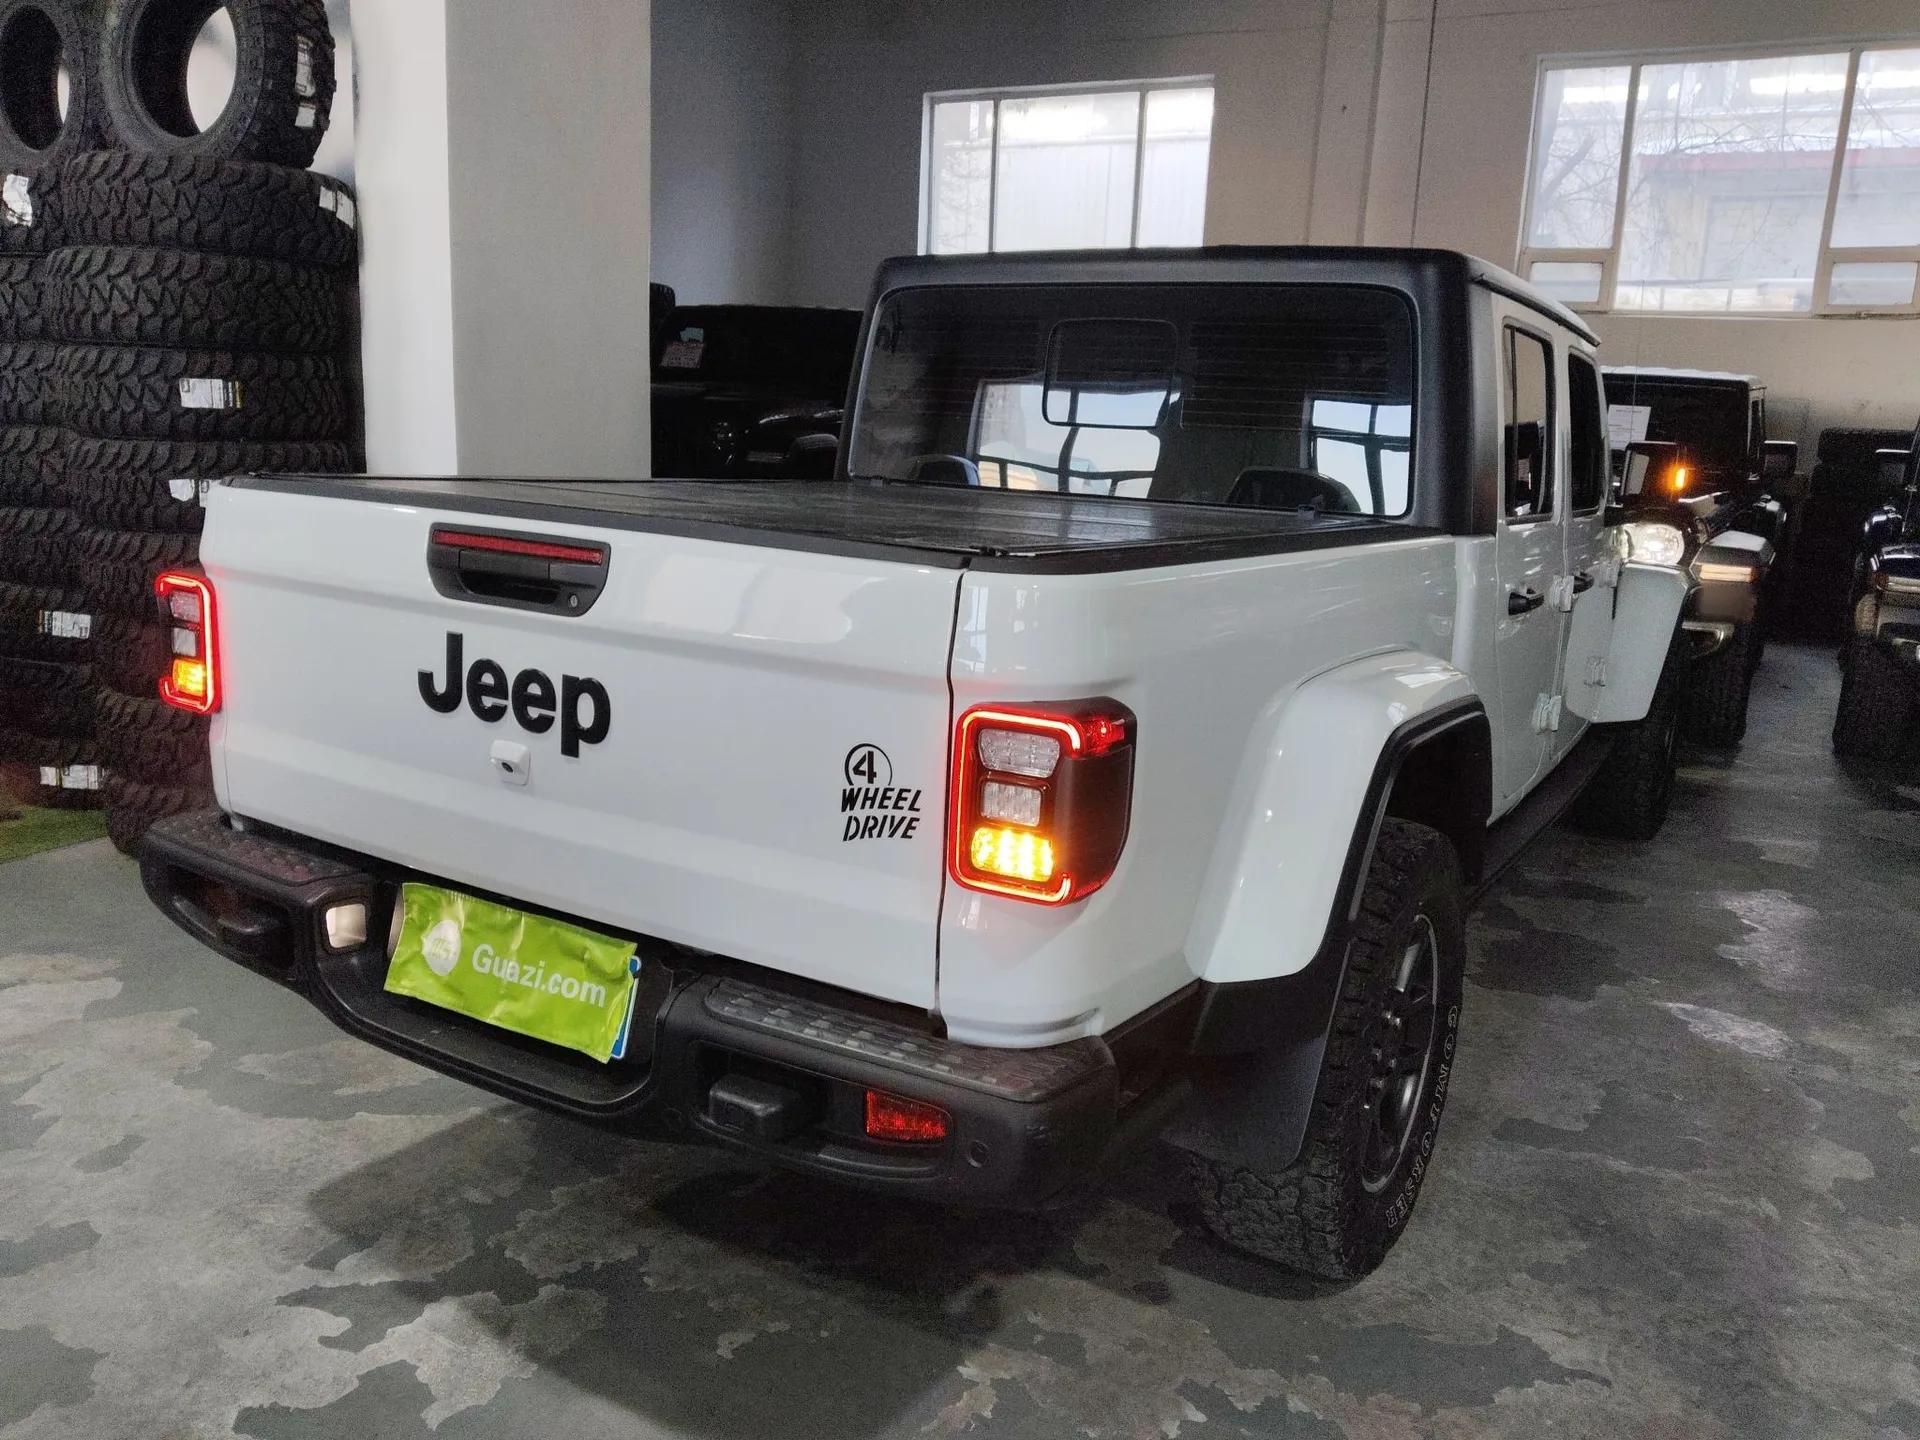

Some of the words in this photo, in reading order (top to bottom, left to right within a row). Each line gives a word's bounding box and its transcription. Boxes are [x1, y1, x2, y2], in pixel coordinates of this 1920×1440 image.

[418, 631, 611, 758] Jeep
[853, 751, 877, 784] 4
[841, 787, 921, 812] WHEEL
[843, 815, 920, 841] DRIVE
[472, 944, 605, 1008] Guazi.com
